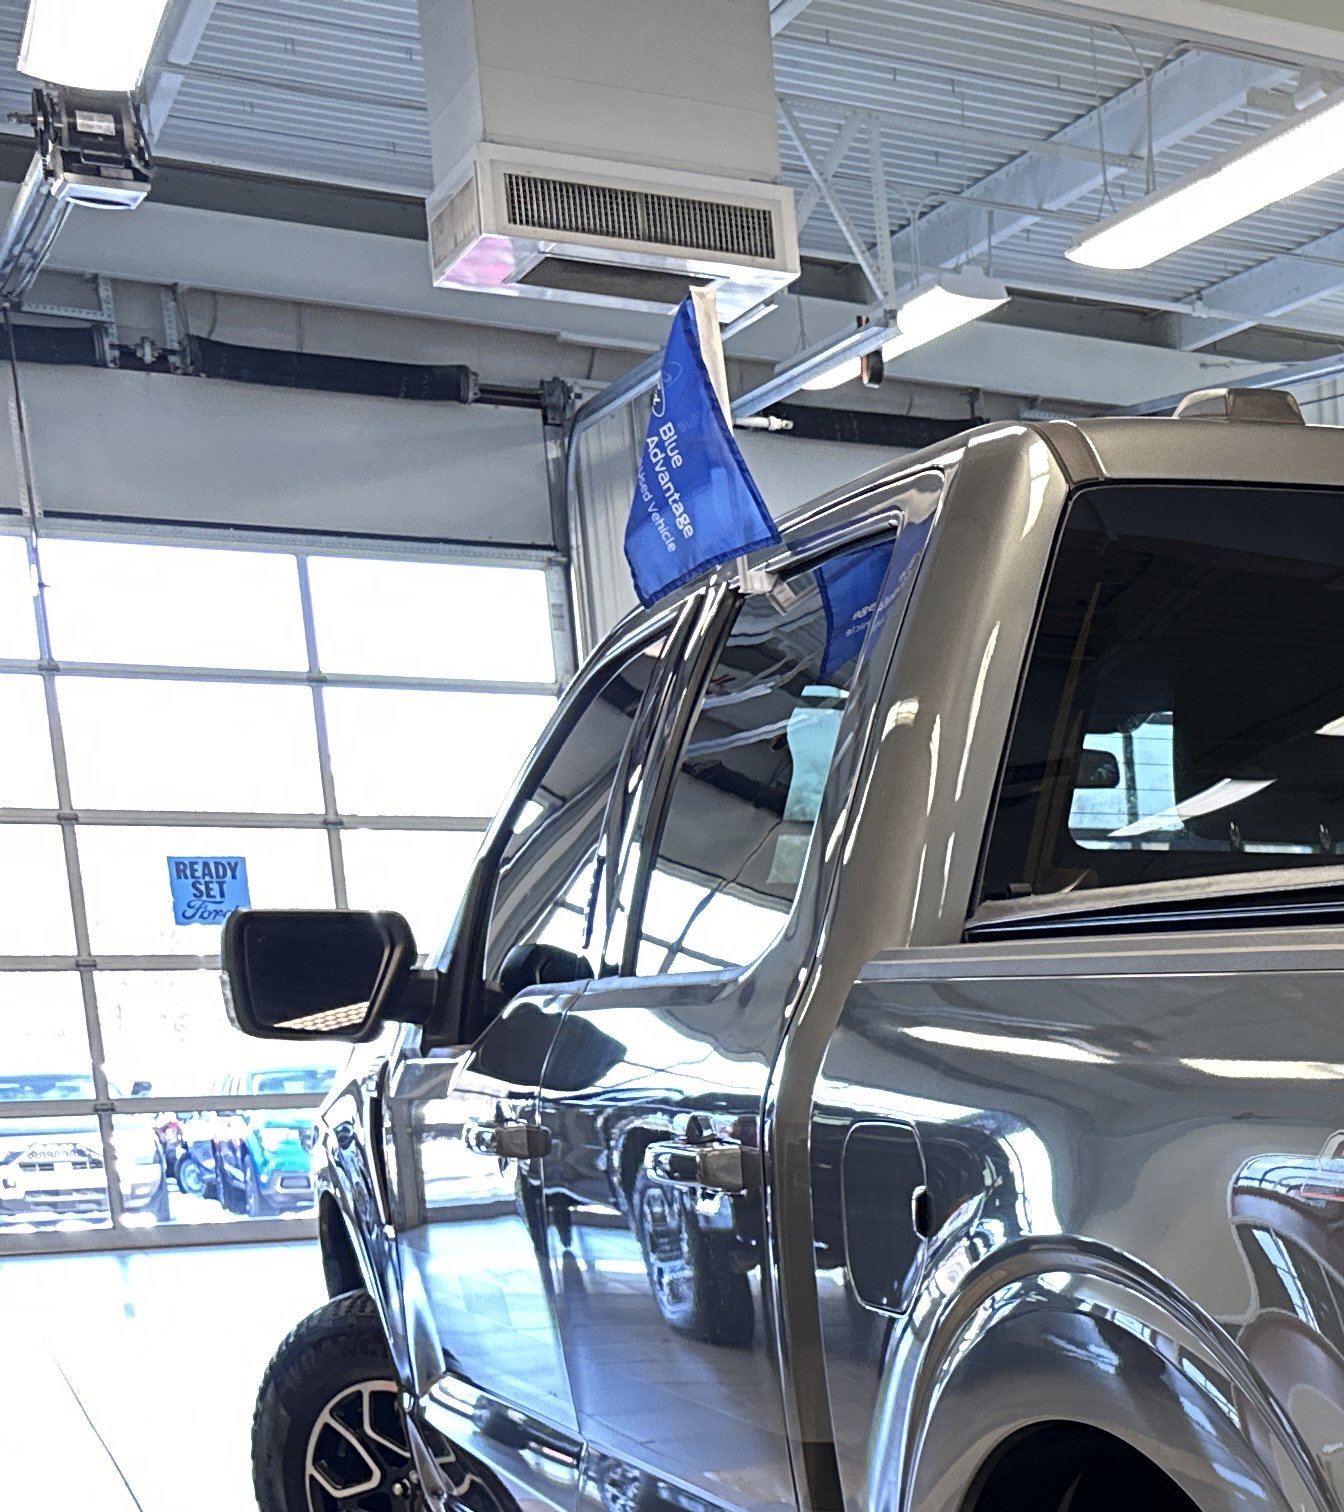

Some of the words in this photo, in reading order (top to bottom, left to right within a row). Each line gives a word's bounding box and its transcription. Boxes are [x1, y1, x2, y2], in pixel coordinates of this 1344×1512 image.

[659, 421, 683, 469] Blue
[646, 436, 694, 540] Advantage
[647, 502, 676, 553] Vehicle
[174, 861, 239, 880] READY
[191, 880, 226, 899] SET
